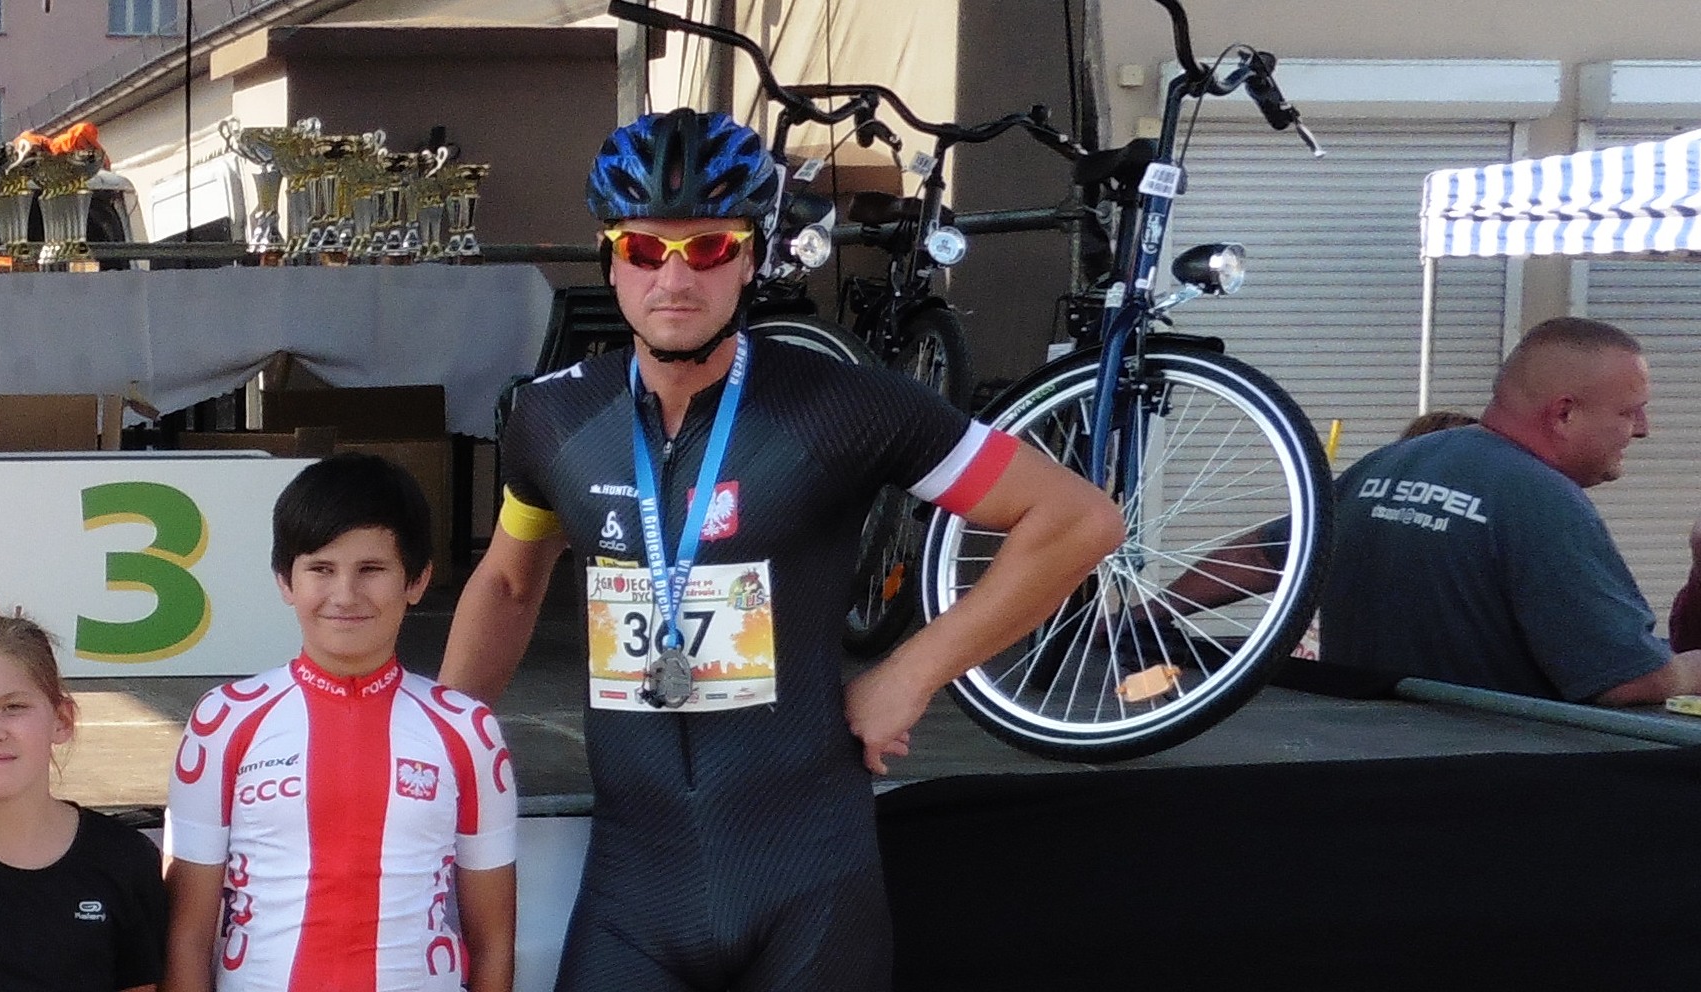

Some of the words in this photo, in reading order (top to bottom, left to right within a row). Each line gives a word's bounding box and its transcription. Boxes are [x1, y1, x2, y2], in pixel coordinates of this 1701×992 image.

[1359, 478, 1391, 498] DJ
[1392, 480, 1487, 524] SOPEL
[75, 480, 212, 664] 3
[238, 777, 301, 805] CCC
